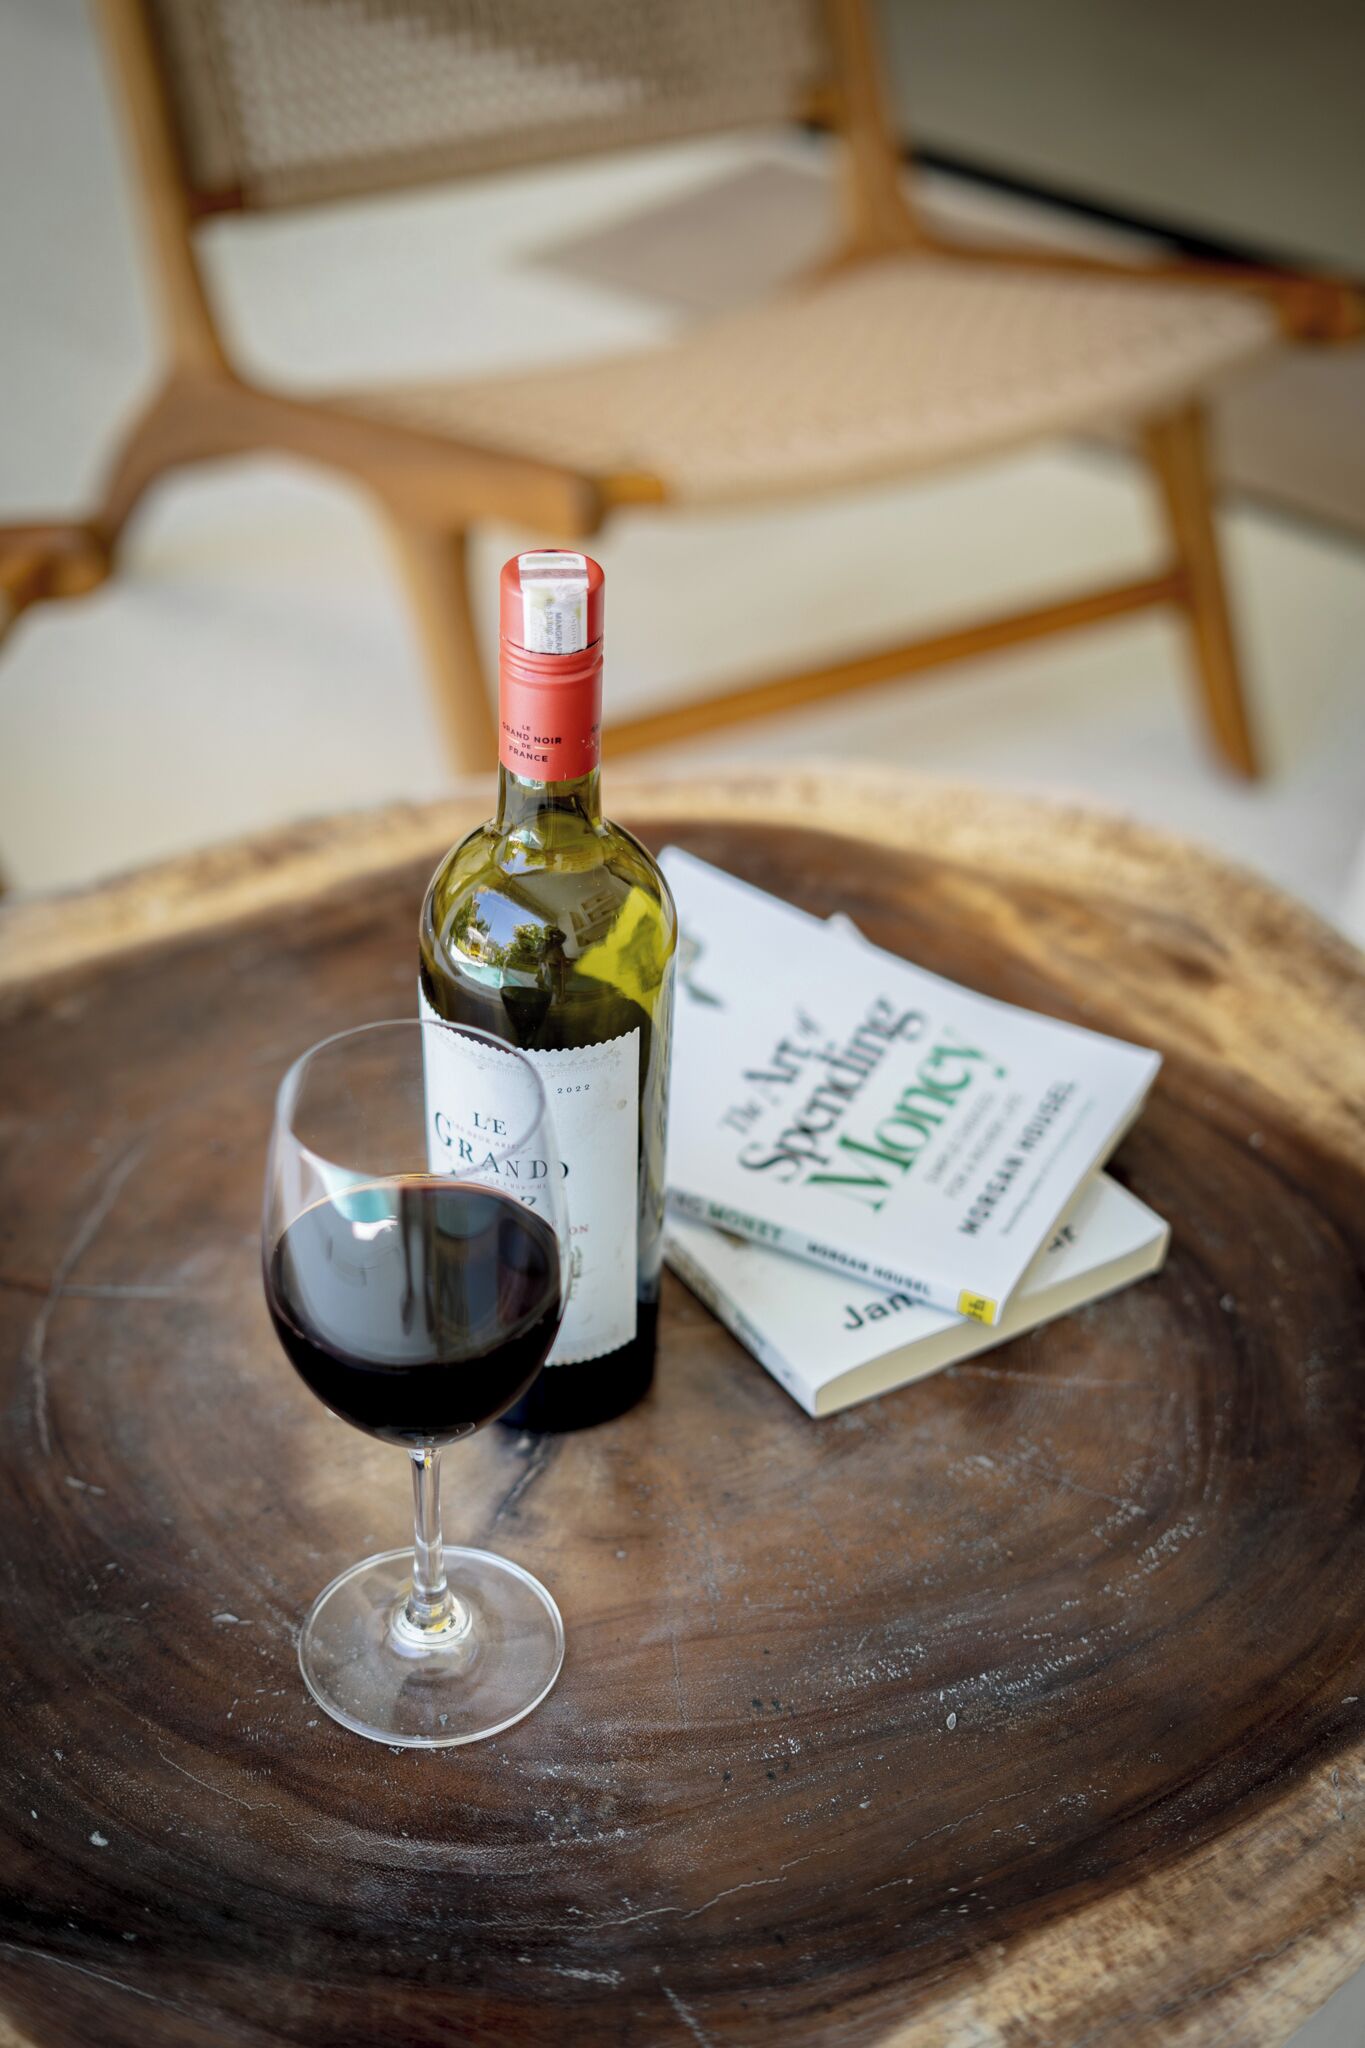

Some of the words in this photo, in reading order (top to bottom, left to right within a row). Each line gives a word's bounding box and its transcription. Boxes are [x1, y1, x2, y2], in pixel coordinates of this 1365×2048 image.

[502, 722, 530, 741] GRAND
[534, 736, 562, 744] NOIR
[509, 745, 548, 762] FRANCE
[557, 1084, 590, 1094] 2022
[738, 994, 928, 1184] Spending
[742, 1038, 811, 1105] Art
[473, 1112, 507, 1136] LE
[805, 1026, 1007, 1212] Money
[958, 1157, 1024, 1238] MORGAN
[1016, 1081, 1078, 1150] HOUSEL
[708, 1201, 781, 1241] MONEY
[806, 1241, 868, 1272] MORGAN
[873, 1266, 930, 1296] HOUSEL
